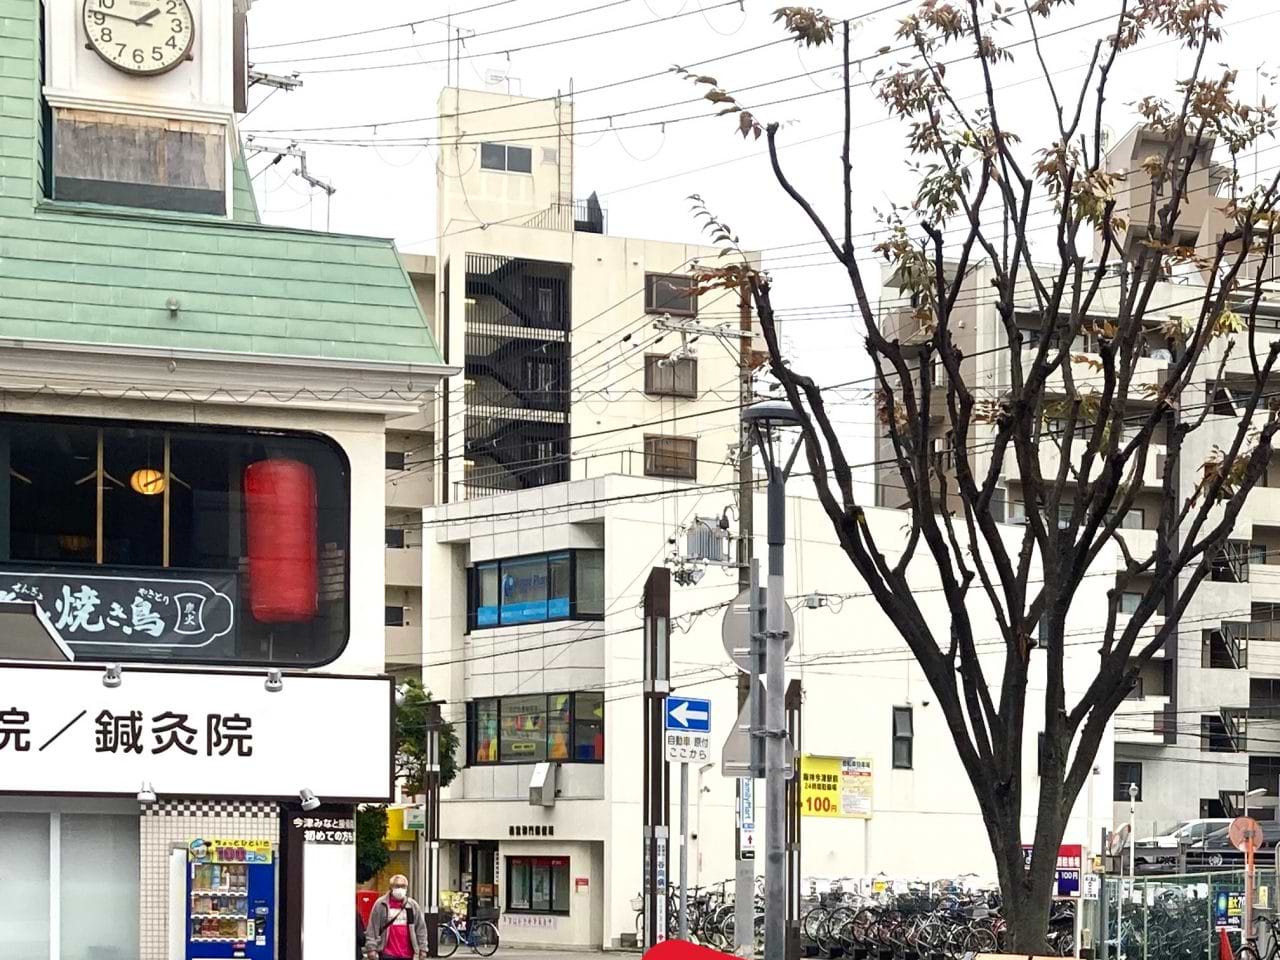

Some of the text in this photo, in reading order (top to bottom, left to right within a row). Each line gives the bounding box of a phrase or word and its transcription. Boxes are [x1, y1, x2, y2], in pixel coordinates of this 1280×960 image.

[166, 1, 177, 15] 2
[93, 10, 105, 25] 9
[171, 18, 182, 33] 3
[101, 27, 112, 43] 8
[165, 35, 177, 49] 4
[115, 42, 127, 57] 7
[132, 49, 144, 64] 6
[152, 46, 163, 61] 5
[55, 584, 165, 637] 焼き鳥
[668, 735, 690, 746] 自動車
[669, 747, 708, 760] ここから
[806, 796, 838, 813] 100円
